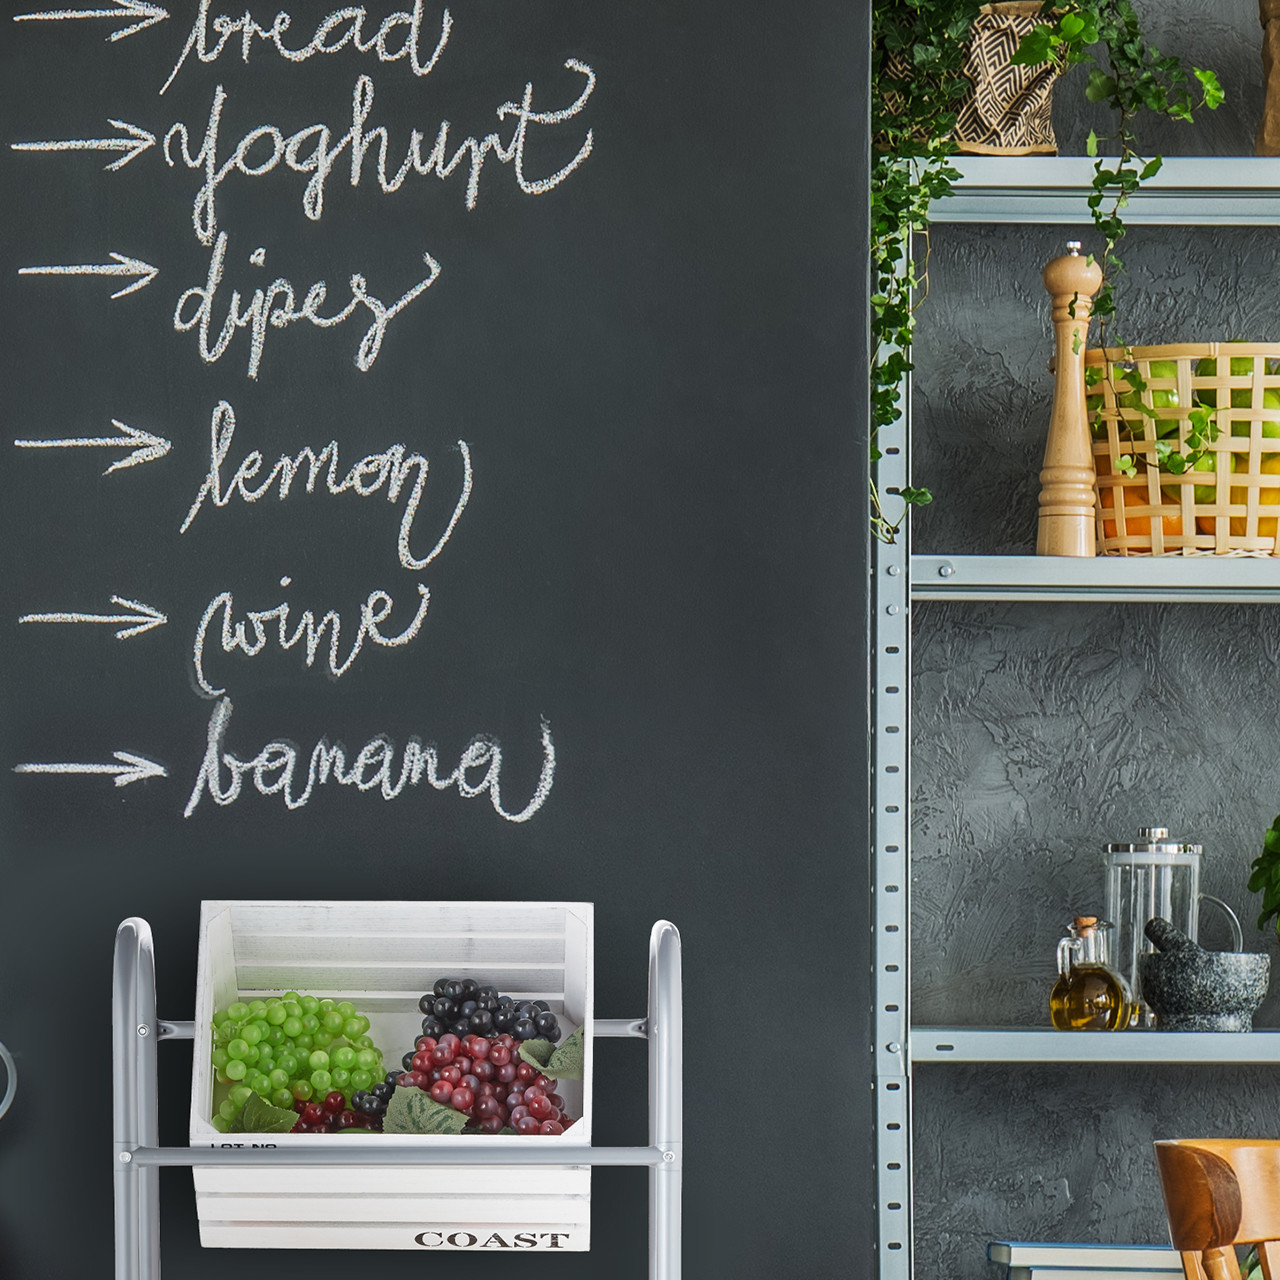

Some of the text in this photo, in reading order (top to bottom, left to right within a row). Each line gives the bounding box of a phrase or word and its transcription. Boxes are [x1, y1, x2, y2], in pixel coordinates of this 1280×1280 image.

[160, 0, 453, 94] bread
[180, 400, 473, 570] lemon
[193, 576, 431, 696] wine
[184, 696, 556, 823] banana
[414, 1231, 570, 1250] COAST
